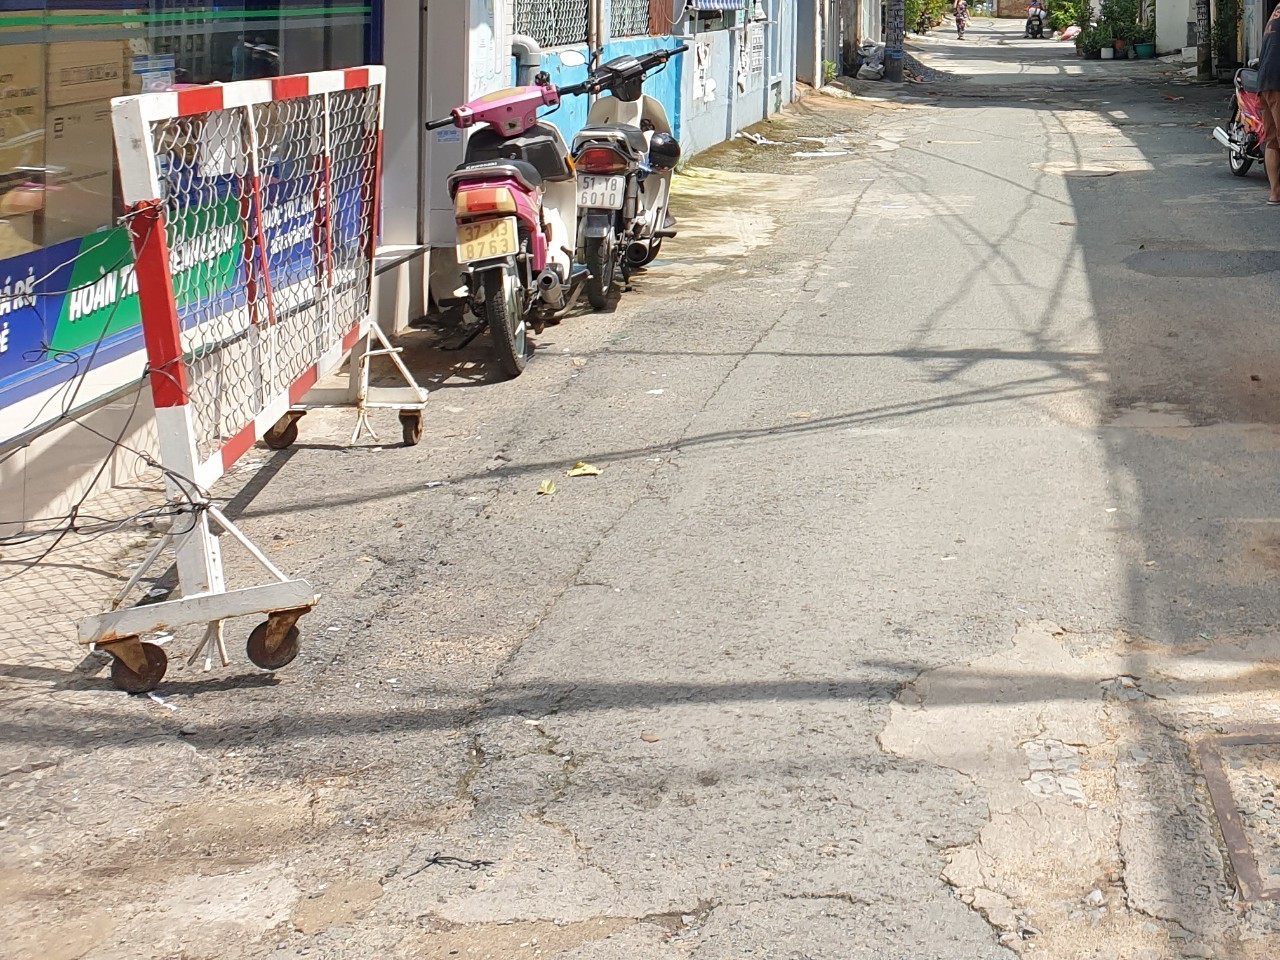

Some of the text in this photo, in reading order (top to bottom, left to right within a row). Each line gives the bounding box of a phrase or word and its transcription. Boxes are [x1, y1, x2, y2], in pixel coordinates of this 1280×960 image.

[580, 193, 617, 207] 6010
[466, 240, 510, 260] 8763
[69, 265, 118, 322] HOÀN
